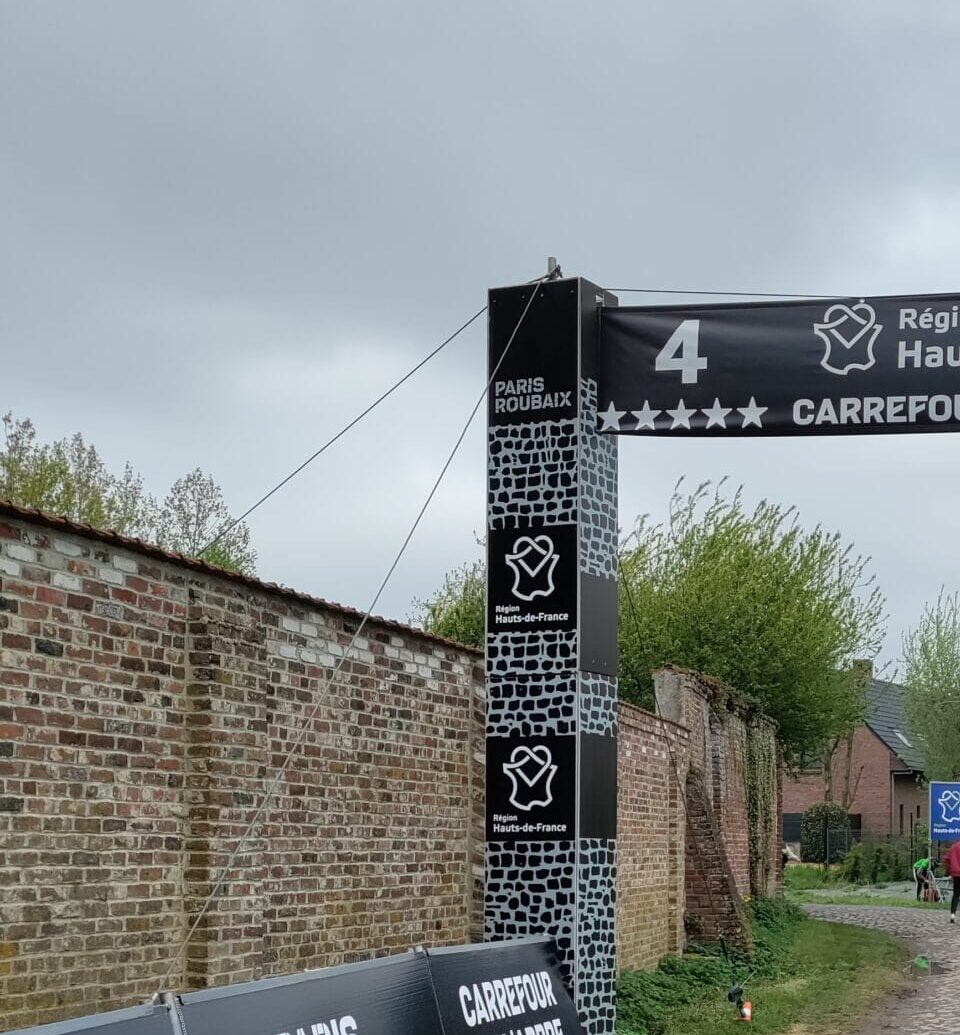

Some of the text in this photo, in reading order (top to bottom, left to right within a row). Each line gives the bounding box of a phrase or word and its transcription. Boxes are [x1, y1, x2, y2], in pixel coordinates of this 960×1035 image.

[654, 319, 708, 384] 4
[495, 376, 545, 397] PARIS
[494, 391, 572, 414] ROUBAIX
[495, 604, 520, 615] Région
[495, 611, 569, 624] Hauts-de-France
[493, 813, 518, 824] Région
[493, 822, 567, 834] Hauts-de-France
[458, 971, 558, 1028] CARREFOUR
